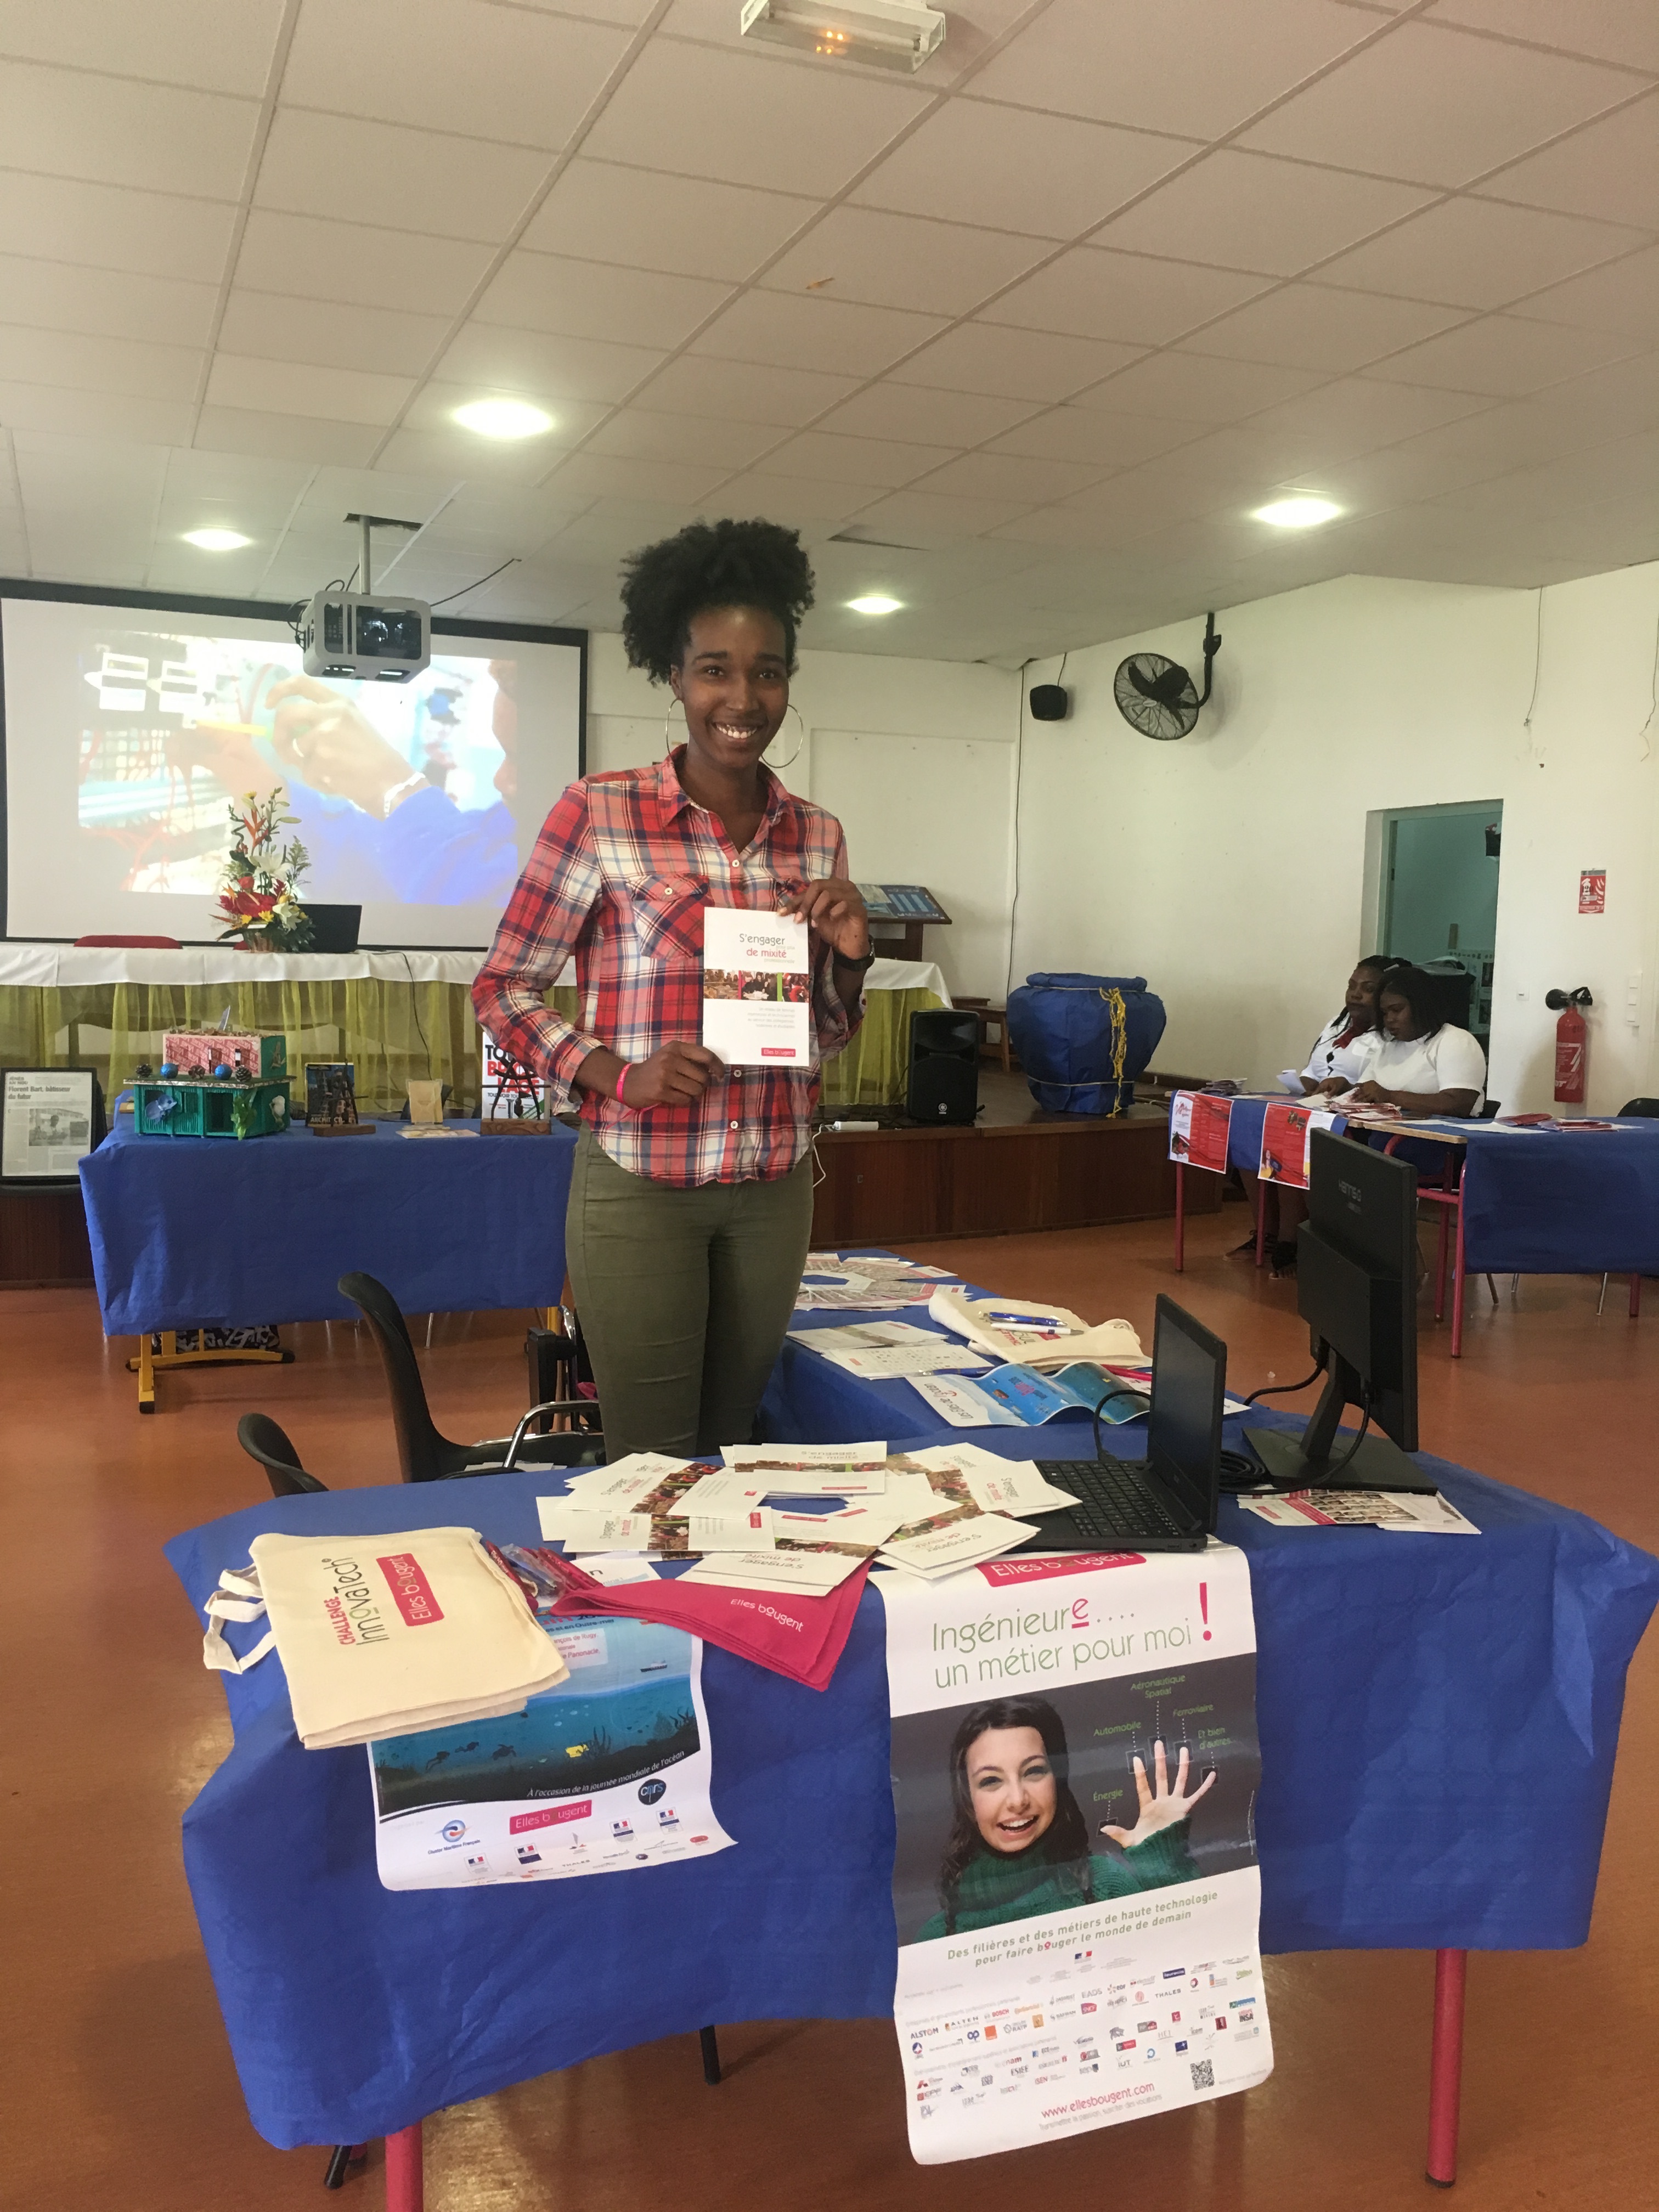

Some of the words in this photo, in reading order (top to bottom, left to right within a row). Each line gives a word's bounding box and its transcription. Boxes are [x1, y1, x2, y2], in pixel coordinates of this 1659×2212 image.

[739, 933, 786, 946] S'engager
[746, 948, 758, 956] de
[761, 949, 787, 958] mixité
[990, 1561, 1042, 1578] Elles
[1041, 1551, 1137, 1571] bougent
[387, 1556, 420, 1596] bougent
[408, 1595, 432, 1620] Elles
[730, 1599, 756, 1610] Elles
[757, 1602, 804, 1633] bougent
[323, 1596, 356, 1645] CHALLENGE
[934, 1663, 969, 1689] un
[978, 1644, 1063, 1682] métier
[1073, 1633, 1135, 1671] pour
[1144, 1617, 1192, 1652] moi
[1130, 1674, 1186, 1691] Aéronautique
[1144, 1686, 1172, 1700] Spatial
[1172, 1703, 1215, 1717] Ferroviaire
[1093, 1720, 1142, 1737] Automobile
[1198, 1730, 1206, 1739] Et
[1207, 1726, 1226, 1737] bien
[535, 1787, 571, 1797] l'occasion
[572, 1786, 582, 1795] de
[582, 1784, 590, 1792] la
[590, 1778, 617, 1792] journée
[618, 1767, 651, 1783] mondiale
[651, 1762, 660, 1771] de
[1093, 1788, 1124, 1802] Énergie
[515, 1816, 540, 1829] Elles
[542, 1804, 588, 1822] bougent
[947, 1946, 969, 1960] Des
[973, 1937, 1015, 1954] filières
[1019, 1933, 1030, 1944] et
[1034, 1927, 1054, 1940] des
[1057, 1917, 1102, 1936] métiers
[1104, 1914, 1119, 1926] de
[1121, 1905, 1153, 1921] haute
[1155, 1890, 1218, 1914] technologie
[975, 1954, 1002, 1968] pour
[1006, 1945, 1034, 1961] faire
[1037, 1937, 1077, 1954] bouger
[1081, 1932, 1092, 1943] le
[1094, 1923, 1132, 1940] monde
[1136, 1918, 1149, 1930] de
[1152, 1910, 1192, 1927] demain
[1081, 1988, 1103, 1999] EADS
[1155, 1988, 1182, 1999] THALES
[991, 2008, 1010, 2018] BOSCH
[1239, 2013, 1254, 2023] INSA
[910, 2027, 939, 2040] ALSTOM
[1041, 2083, 1156, 2119] www.ellesbougent.com
